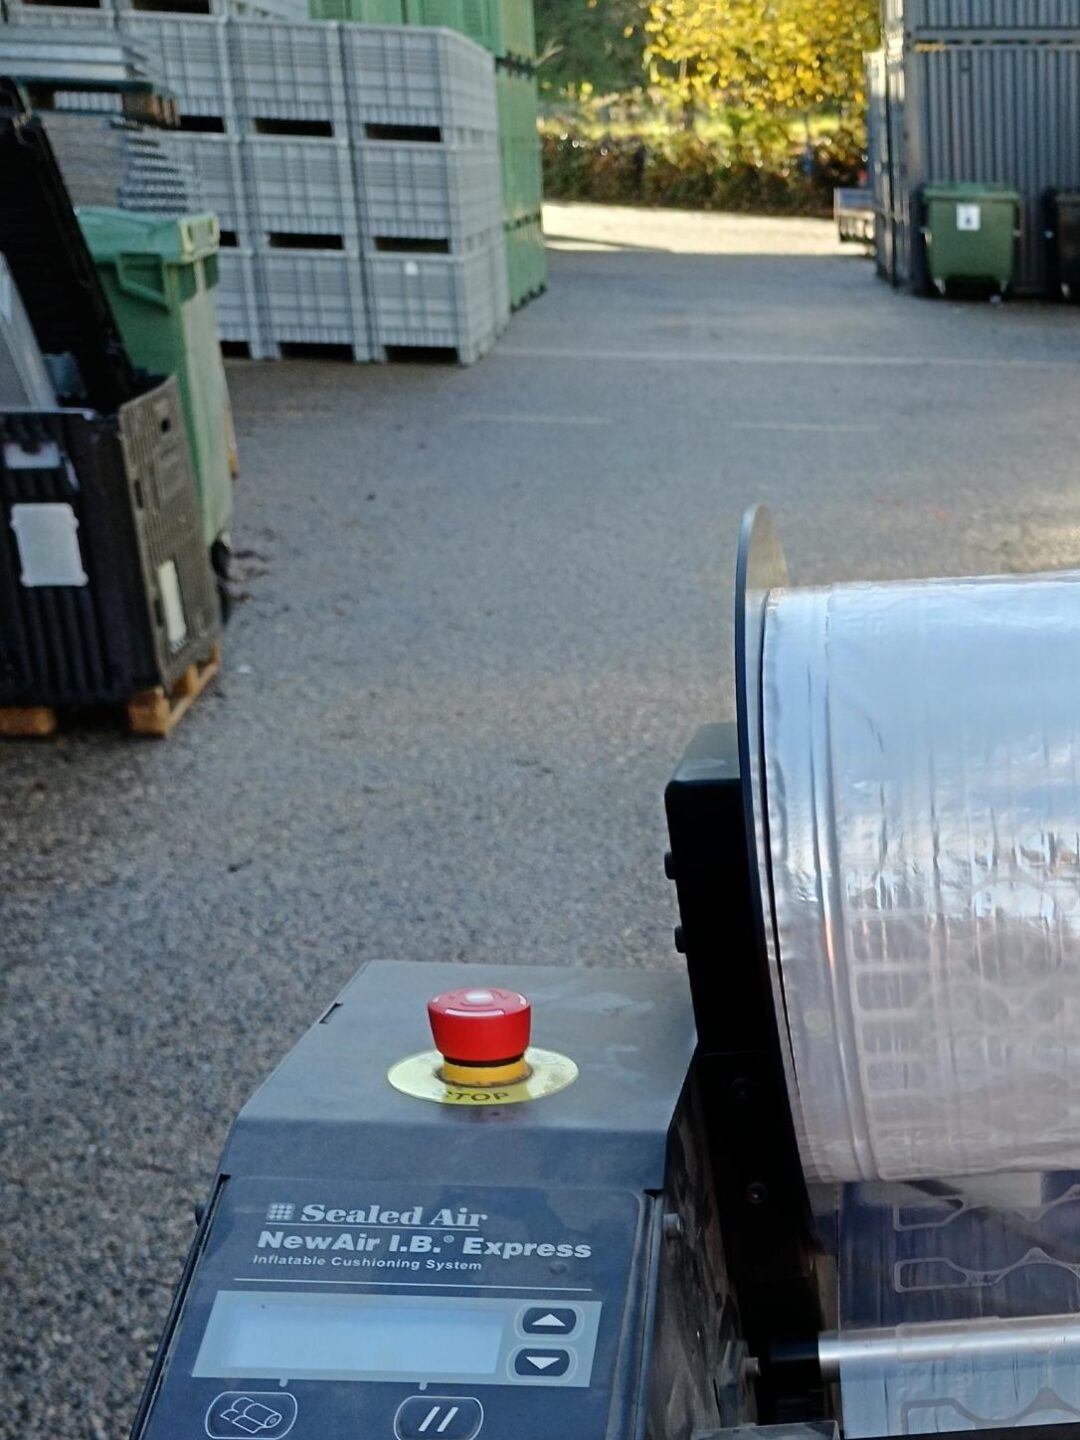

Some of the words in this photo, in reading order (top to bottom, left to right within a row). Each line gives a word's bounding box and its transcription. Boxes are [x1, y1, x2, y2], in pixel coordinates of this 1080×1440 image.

[300, 1204, 423, 1225] Sealed
[429, 1207, 489, 1227] Air
[257, 1230, 381, 1251] NewAir
[462, 1237, 593, 1259] Express
[252, 1254, 327, 1266] Inflatable
[331, 1256, 421, 1271] Cushioning
[425, 1259, 482, 1271] System
